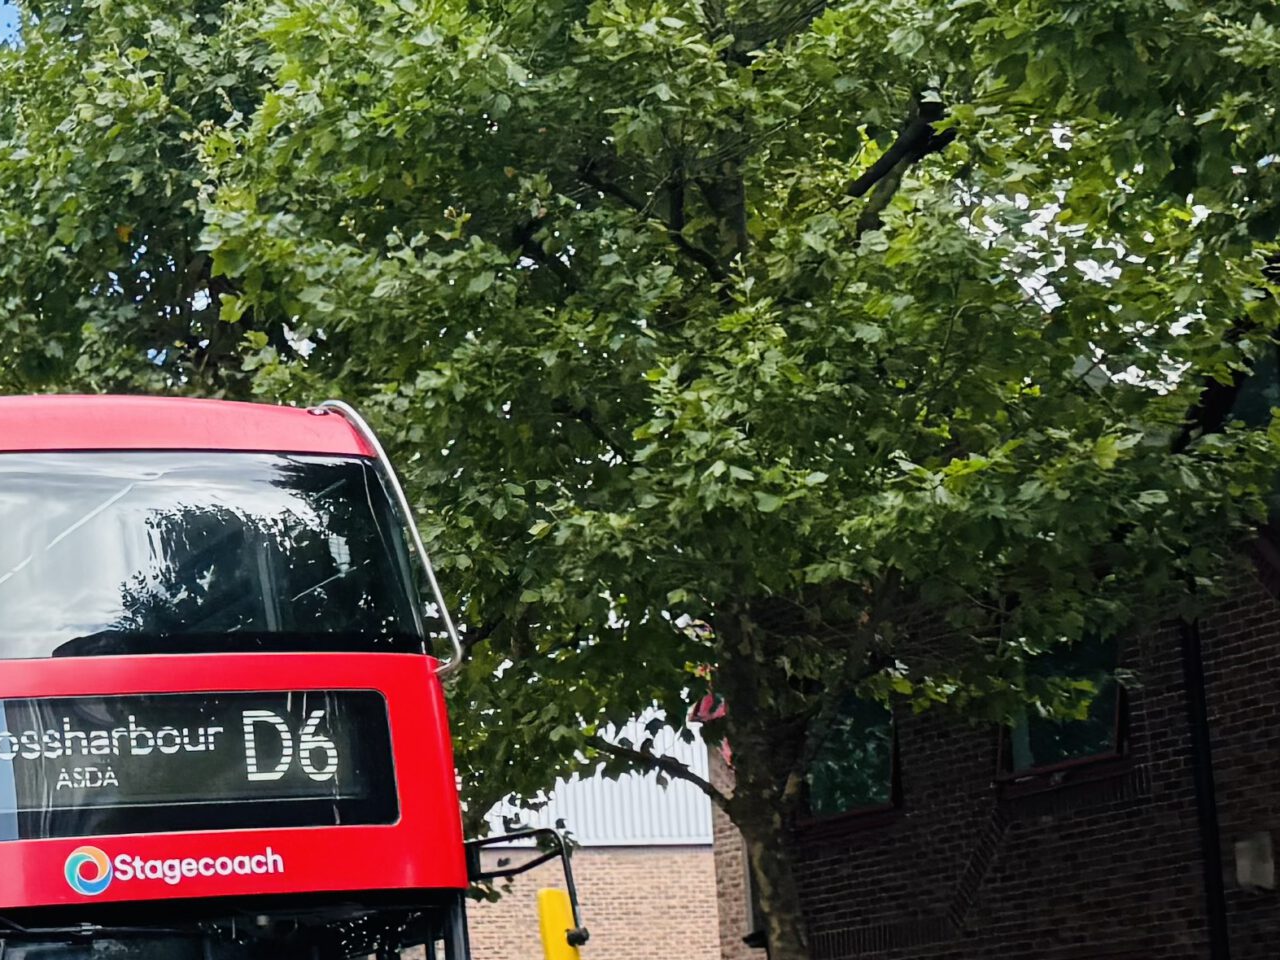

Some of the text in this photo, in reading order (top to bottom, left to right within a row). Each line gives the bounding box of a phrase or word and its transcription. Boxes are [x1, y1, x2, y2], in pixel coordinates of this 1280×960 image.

[241, 709, 340, 782] D6
[56, 765, 119, 791] ASDA
[113, 846, 285, 886] Stagecoach
